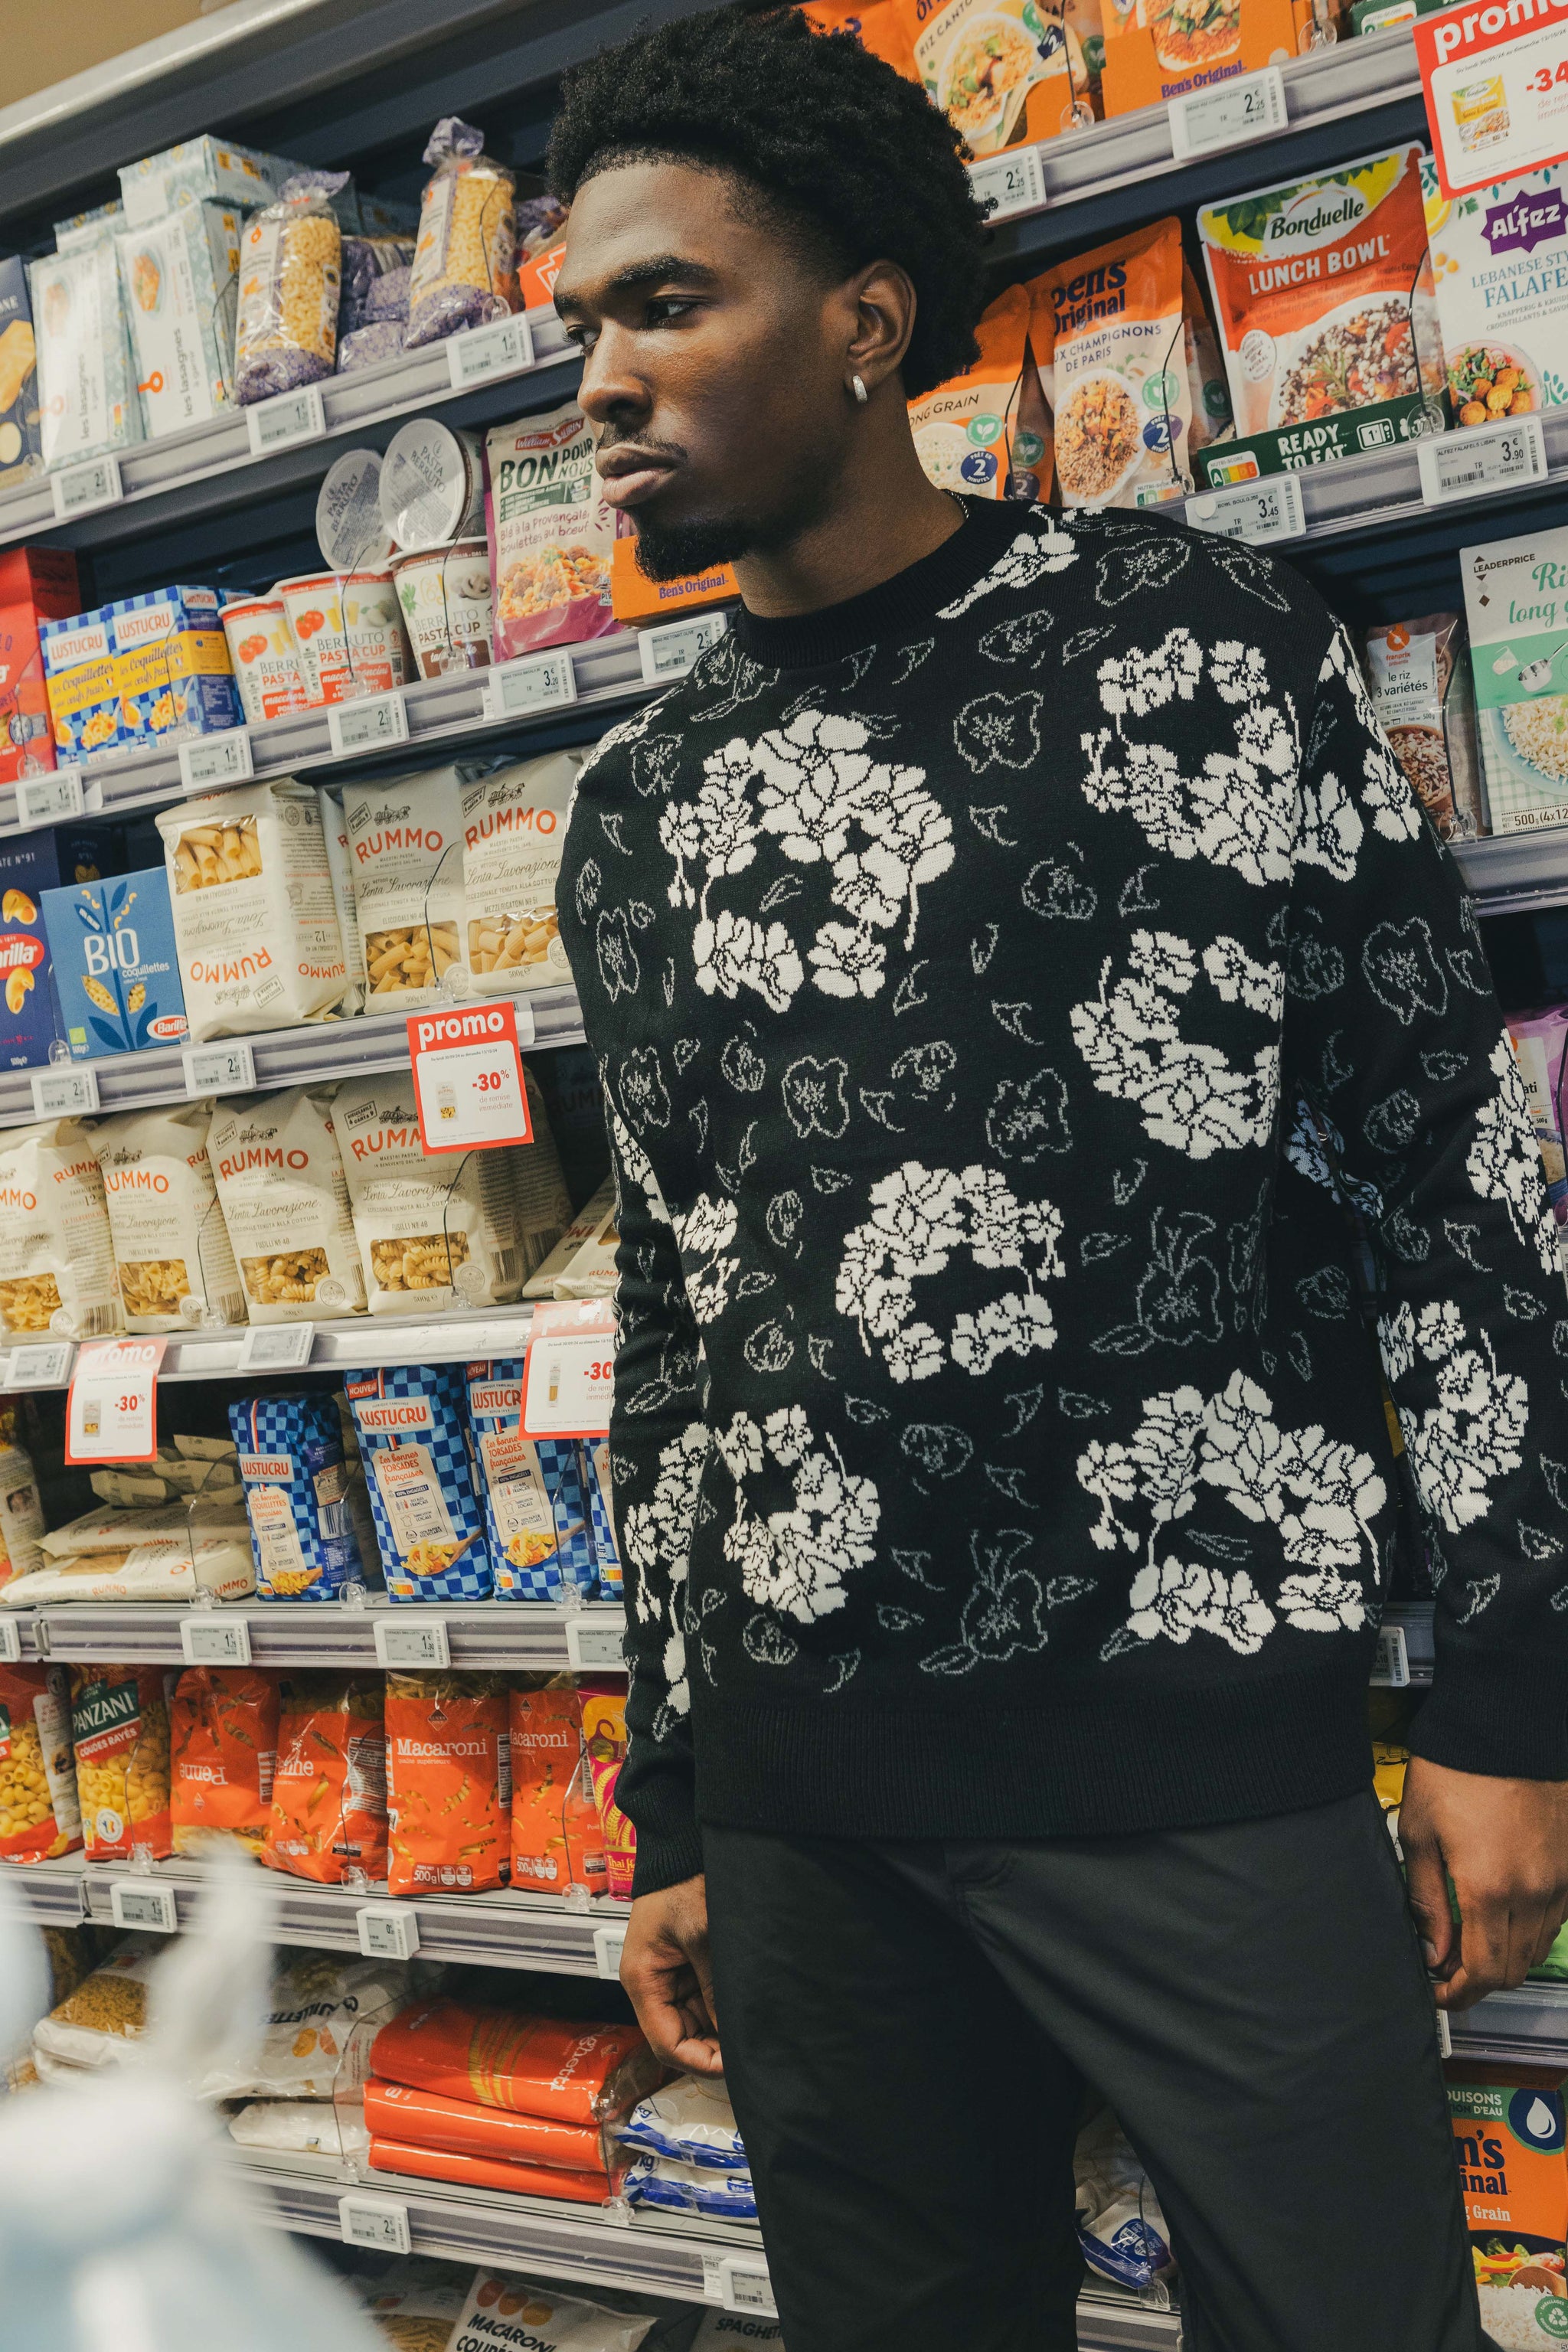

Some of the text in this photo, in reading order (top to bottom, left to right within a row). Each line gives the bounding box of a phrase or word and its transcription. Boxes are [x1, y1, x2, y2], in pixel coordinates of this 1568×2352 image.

[1433, 0, 1568, 65] prom
[919, 36, 936, 58] RIZ
[1161, 60, 1243, 99] Ben's Original
[1271, 197, 1364, 240] Bonduelle
[1250, 257, 1321, 296] LUNCH
[1328, 235, 1390, 273] BOWL
[1472, 257, 1542, 289] LEBANESE
[1070, 324, 1161, 356] CHAMPIGNONS
[1066, 346, 1111, 373] DE PARIS
[933, 394, 979, 414] GRAIN
[1278, 423, 1339, 456] READY
[421, 446, 443, 477] PASTA
[1501, 441, 1524, 462] 3.90
[500, 437, 593, 494] BON POUR
[558, 457, 593, 480] NOUS
[973, 459, 986, 476] 2
[1258, 498, 1279, 518] 3.45
[501, 535, 542, 555] boulettes
[544, 529, 554, 541] au
[1473, 554, 1536, 573] LEADERPRICE
[659, 573, 726, 599] Ben's Original
[1509, 600, 1560, 628] long
[118, 612, 171, 641] LUSTUCRU
[455, 622, 481, 635] CUP
[51, 634, 103, 662] LUSTUCRU
[129, 641, 184, 671] Coquillettes
[362, 645, 386, 657] CUP
[1386, 652, 1411, 662] franprix
[62, 662, 114, 691] Coquillettes
[262, 671, 301, 687] PASTA
[1388, 670, 1411, 682] le riz
[1384, 681, 1429, 696] variétés
[465, 807, 557, 851] RUMMO
[355, 828, 443, 864] RUMMO
[466, 858, 561, 887] Lenta Lavorazione
[360, 882, 384, 899] Lenta
[84, 928, 141, 976] BIO
[122, 962, 170, 978] coquillettes
[190, 946, 273, 984] RUMMO
[418, 1011, 505, 1050] promo
[479, 1093, 511, 1103] de remise
[479, 1101, 513, 1113] immédiate
[351, 1128, 421, 1161] RUMM
[54, 1160, 102, 1184] RUMM
[219, 1148, 309, 1181] RUMMO
[363, 1187, 387, 1202] Lenta
[228, 1198, 318, 1221] Lenta Lavorazione
[472, 1389, 521, 1409] LUSTUCR
[359, 1406, 427, 1426] LUSTUCRU
[486, 1438, 495, 1449] Les
[488, 1442, 522, 1459] TORSADES
[241, 1462, 289, 1476] LUSTUCRU
[379, 1451, 420, 1465] Les bonnes
[383, 1460, 419, 1472] TORSADES
[490, 1454, 526, 1471] françaises
[384, 1469, 424, 1485] françaises
[92, 1583, 127, 1596] RUMMO
[214, 1579, 248, 1596] UMMO
[73, 1690, 136, 1732] PANZANI
[79, 1726, 138, 1758] COUDES RAYÉS
[397, 1737, 488, 1757] Macaroni
[180, 1762, 229, 1785] Penne
[1473, 2105, 1503, 2116] D'EAU
[1473, 2205, 1511, 2222] Grain
